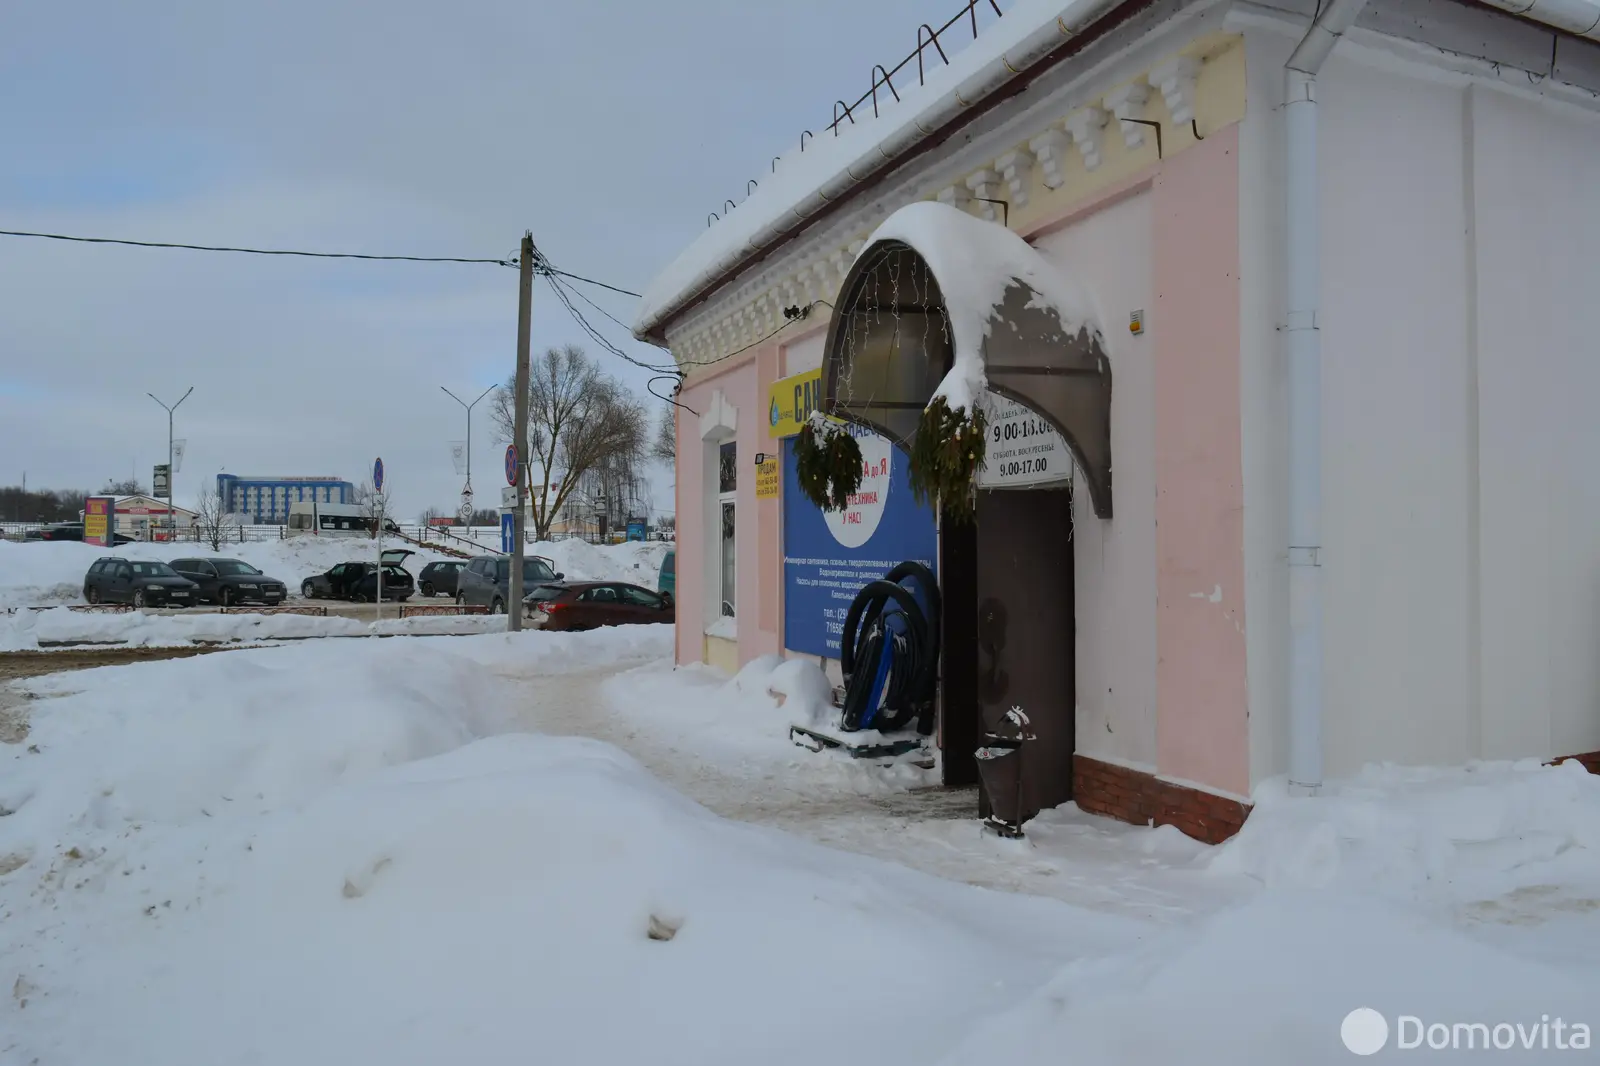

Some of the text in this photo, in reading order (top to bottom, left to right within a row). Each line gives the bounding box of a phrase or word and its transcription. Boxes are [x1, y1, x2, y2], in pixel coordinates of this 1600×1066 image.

[795, 378, 821, 423] САН
[863, 458, 887, 478] А до Я
[1000, 458, 1047, 476] 9.00-17.00
[846, 492, 878, 505] НТЕХНИКА
[842, 512, 862, 524] У НАС!
[825, 640, 842, 649] www.
